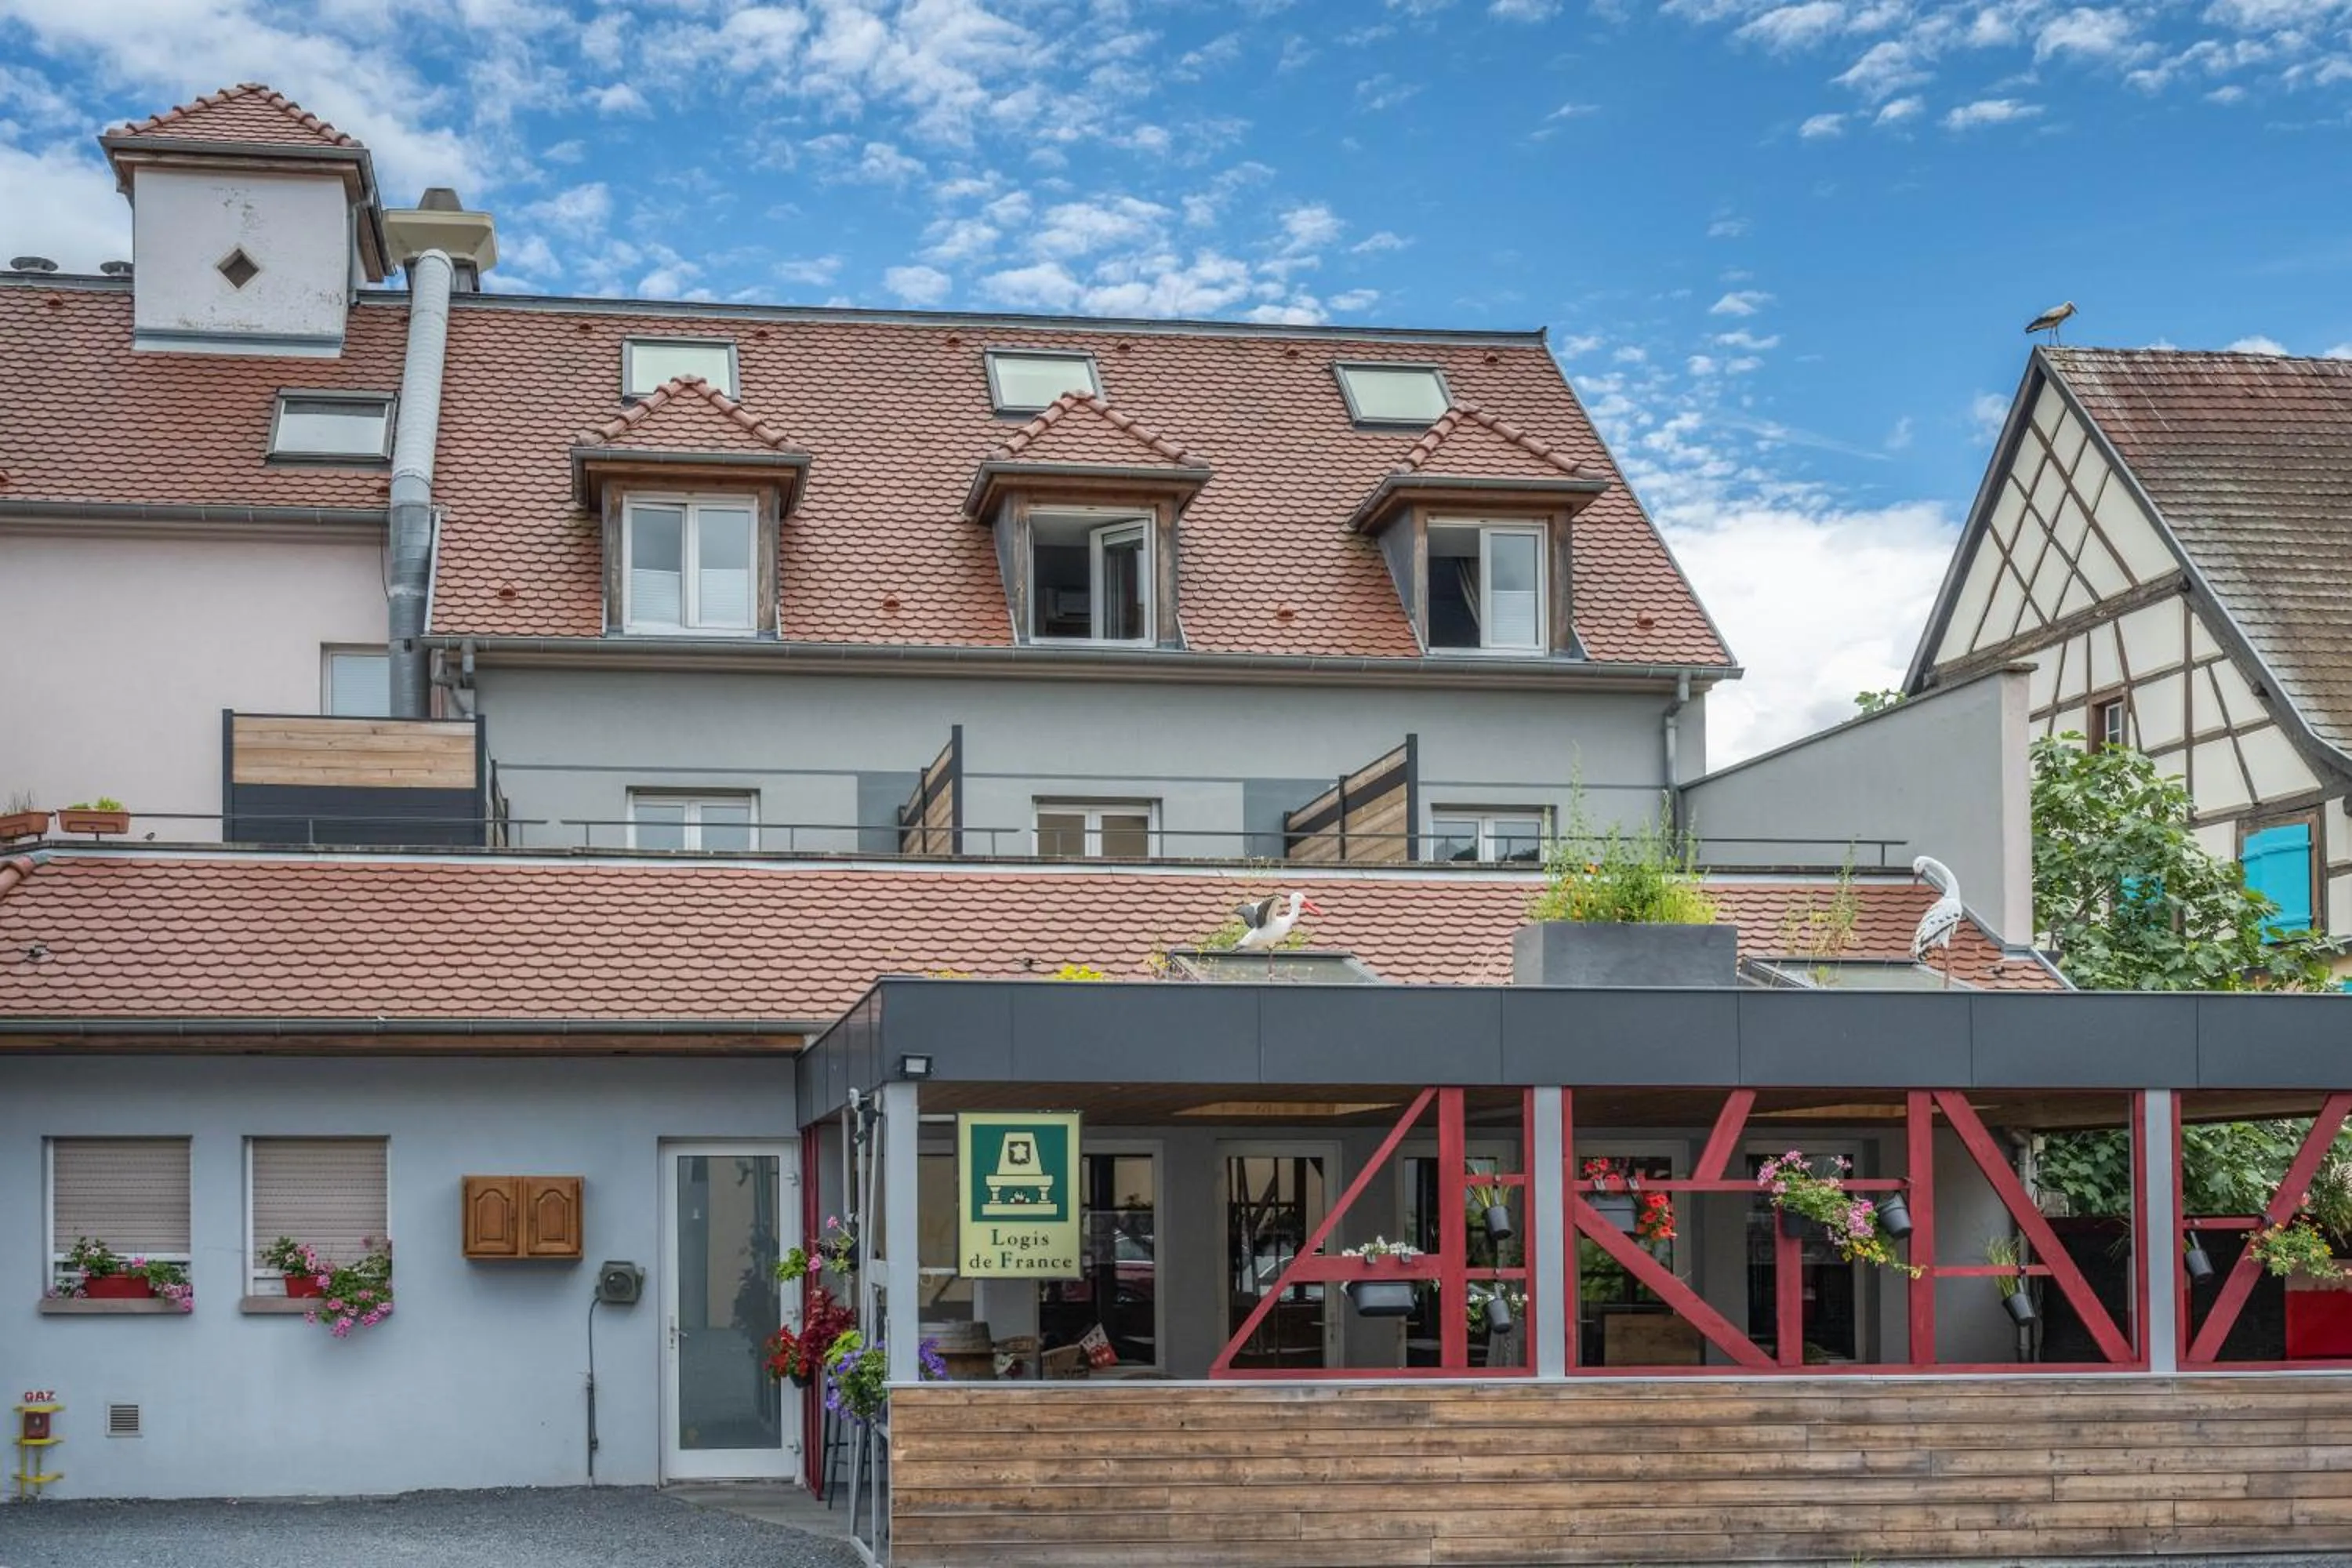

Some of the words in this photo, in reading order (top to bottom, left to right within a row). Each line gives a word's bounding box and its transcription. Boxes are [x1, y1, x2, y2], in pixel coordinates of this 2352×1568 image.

[991, 1229, 1050, 1249] Logis
[969, 1254, 992, 1269] de
[1000, 1251, 1073, 1269] France
[24, 1391, 56, 1403] GAZ
